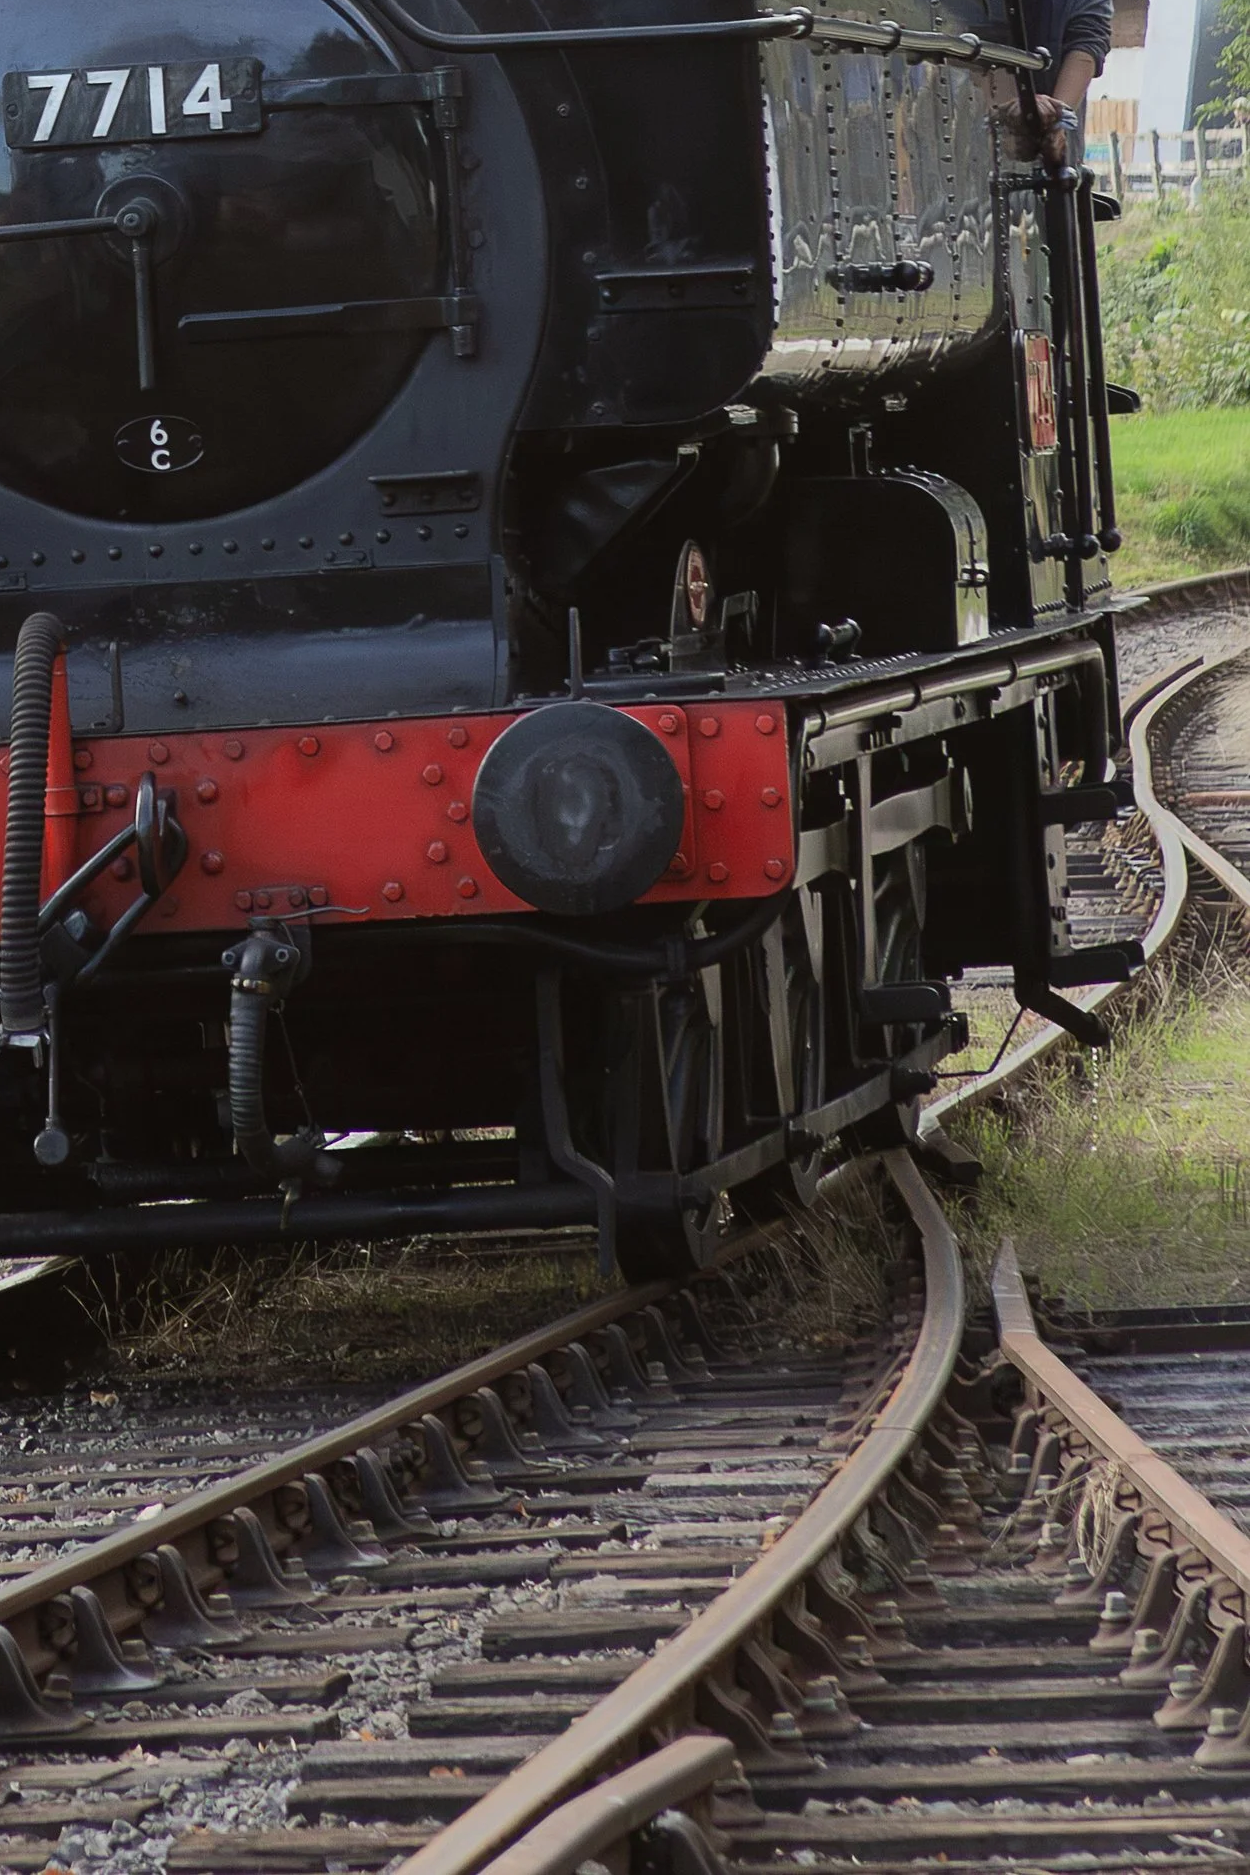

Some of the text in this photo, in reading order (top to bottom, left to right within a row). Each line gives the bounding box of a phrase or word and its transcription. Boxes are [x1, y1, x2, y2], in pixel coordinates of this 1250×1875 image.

[27, 63, 232, 142] 7714
[150, 419, 168, 446] 6
[151, 449, 171, 470] C
